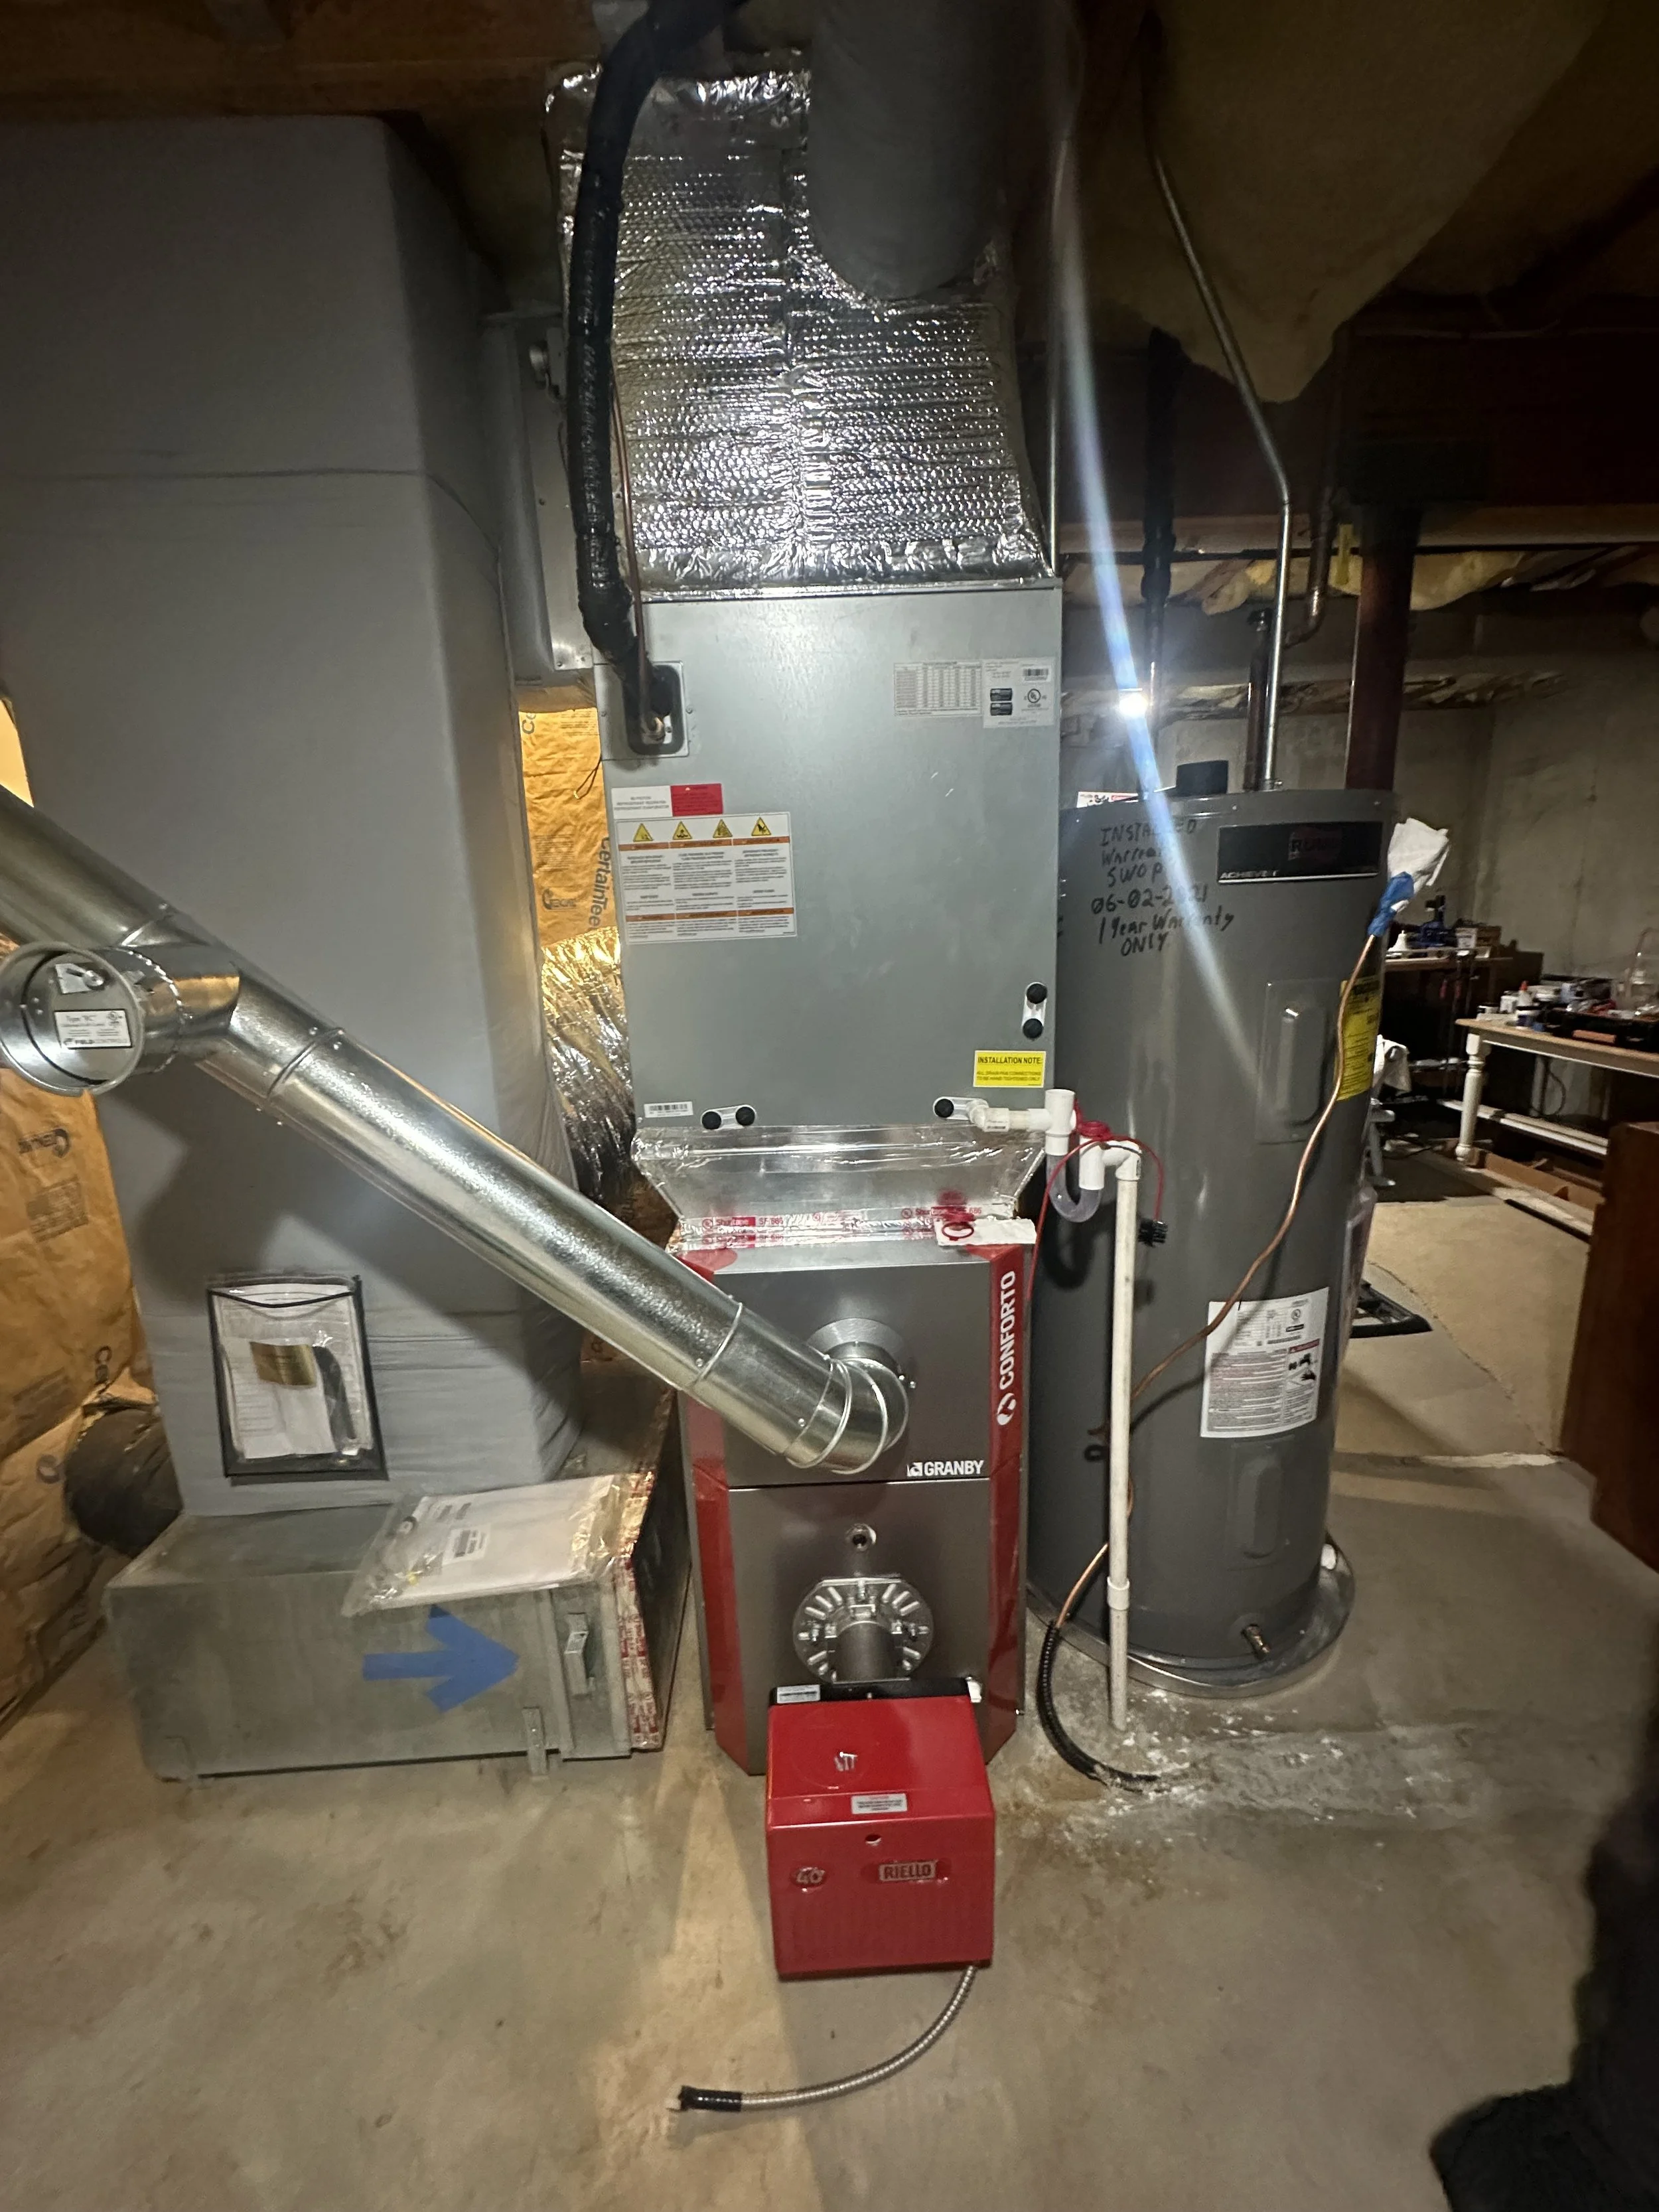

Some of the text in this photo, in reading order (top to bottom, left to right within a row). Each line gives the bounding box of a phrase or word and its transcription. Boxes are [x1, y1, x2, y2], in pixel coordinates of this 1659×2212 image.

[1100, 820, 1197, 846] INSTAED
[1102, 847, 1172, 865] Warra
[588, 837, 612, 930] ertainTee
[1091, 883, 1208, 915] 06-02-221
[1153, 905, 1234, 932] Warnty
[999, 1270, 1016, 1390] CONFORTO
[924, 1459, 985, 1477] GRANBY
[884, 1863, 931, 1880] RIELLO
